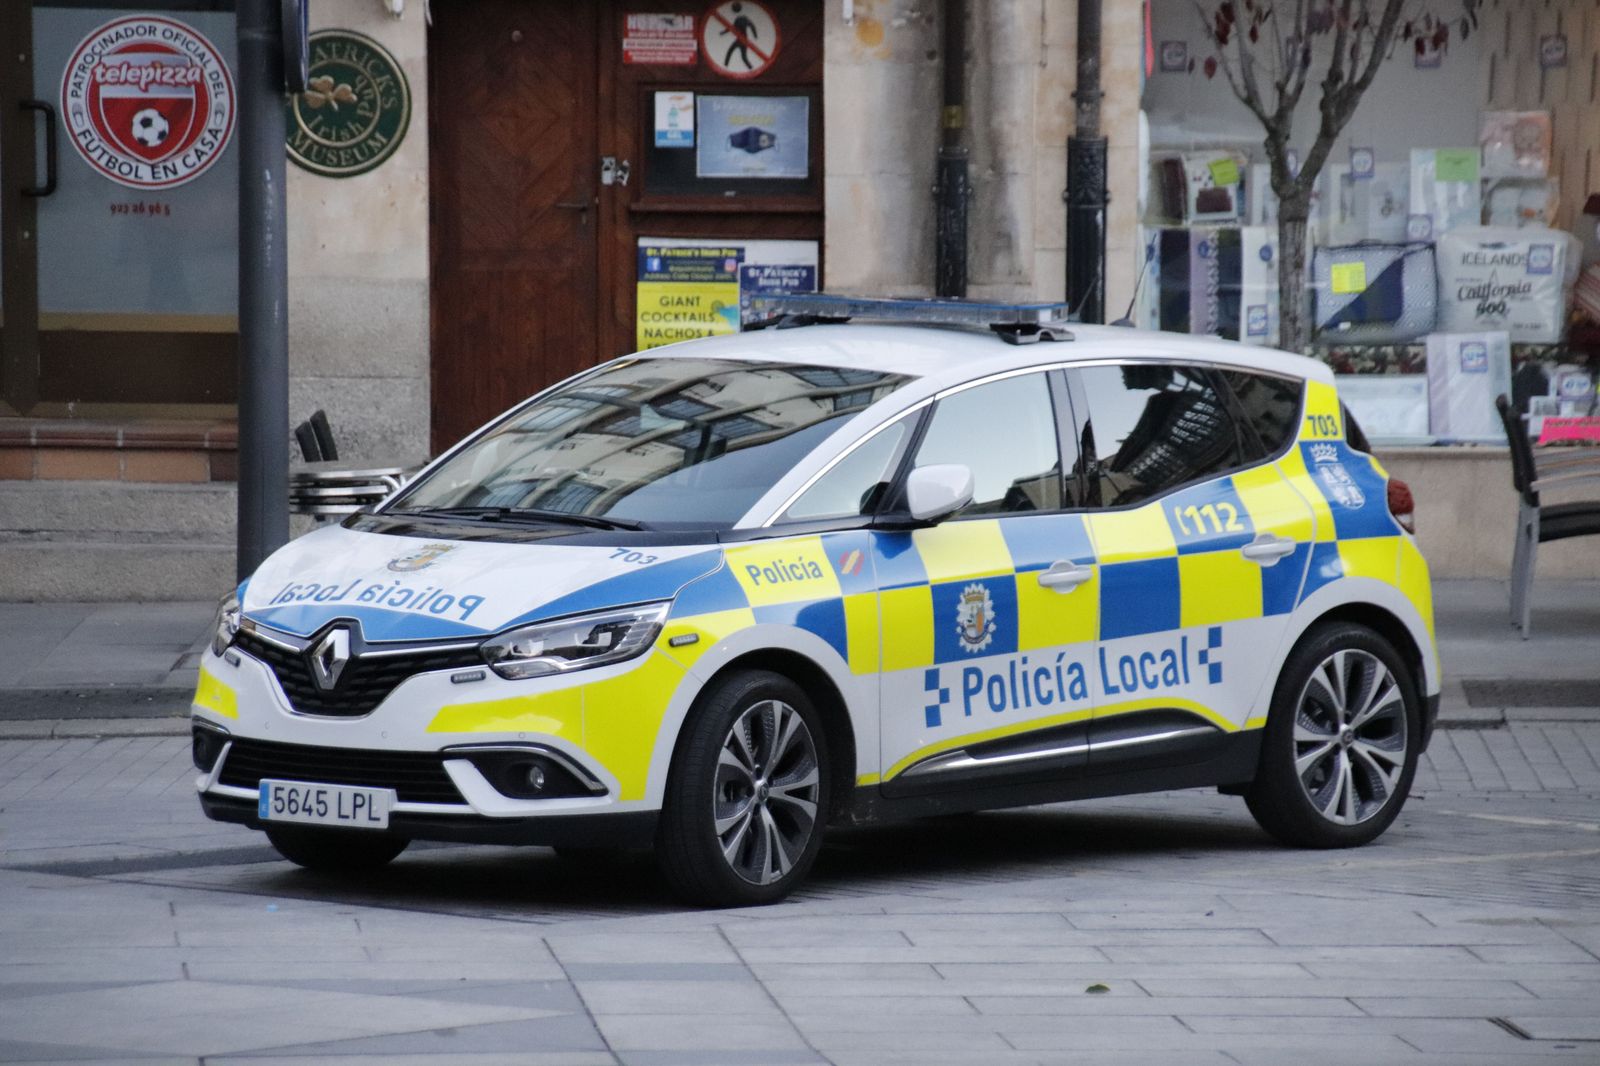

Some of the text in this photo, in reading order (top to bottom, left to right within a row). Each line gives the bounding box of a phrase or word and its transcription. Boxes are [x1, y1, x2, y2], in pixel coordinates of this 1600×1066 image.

[71, 24, 225, 99] PATROCINADOR OFICIAL DEL
[94, 61, 202, 92] telepizza
[77, 127, 223, 180] FUTBOL EN CASA
[287, 130, 388, 166] MUSEUM
[640, 312, 715, 322] COCKTAILS
[659, 296, 701, 307] GIANT
[644, 328, 702, 338] NACHOS
[1307, 415, 1338, 436] 703
[1184, 502, 1245, 534] 112
[608, 547, 658, 565] 703
[745, 556, 824, 586] Policía
[962, 635, 1190, 717] Policía Local
[274, 786, 328, 818] 5645
[338, 791, 381, 821] LPL
